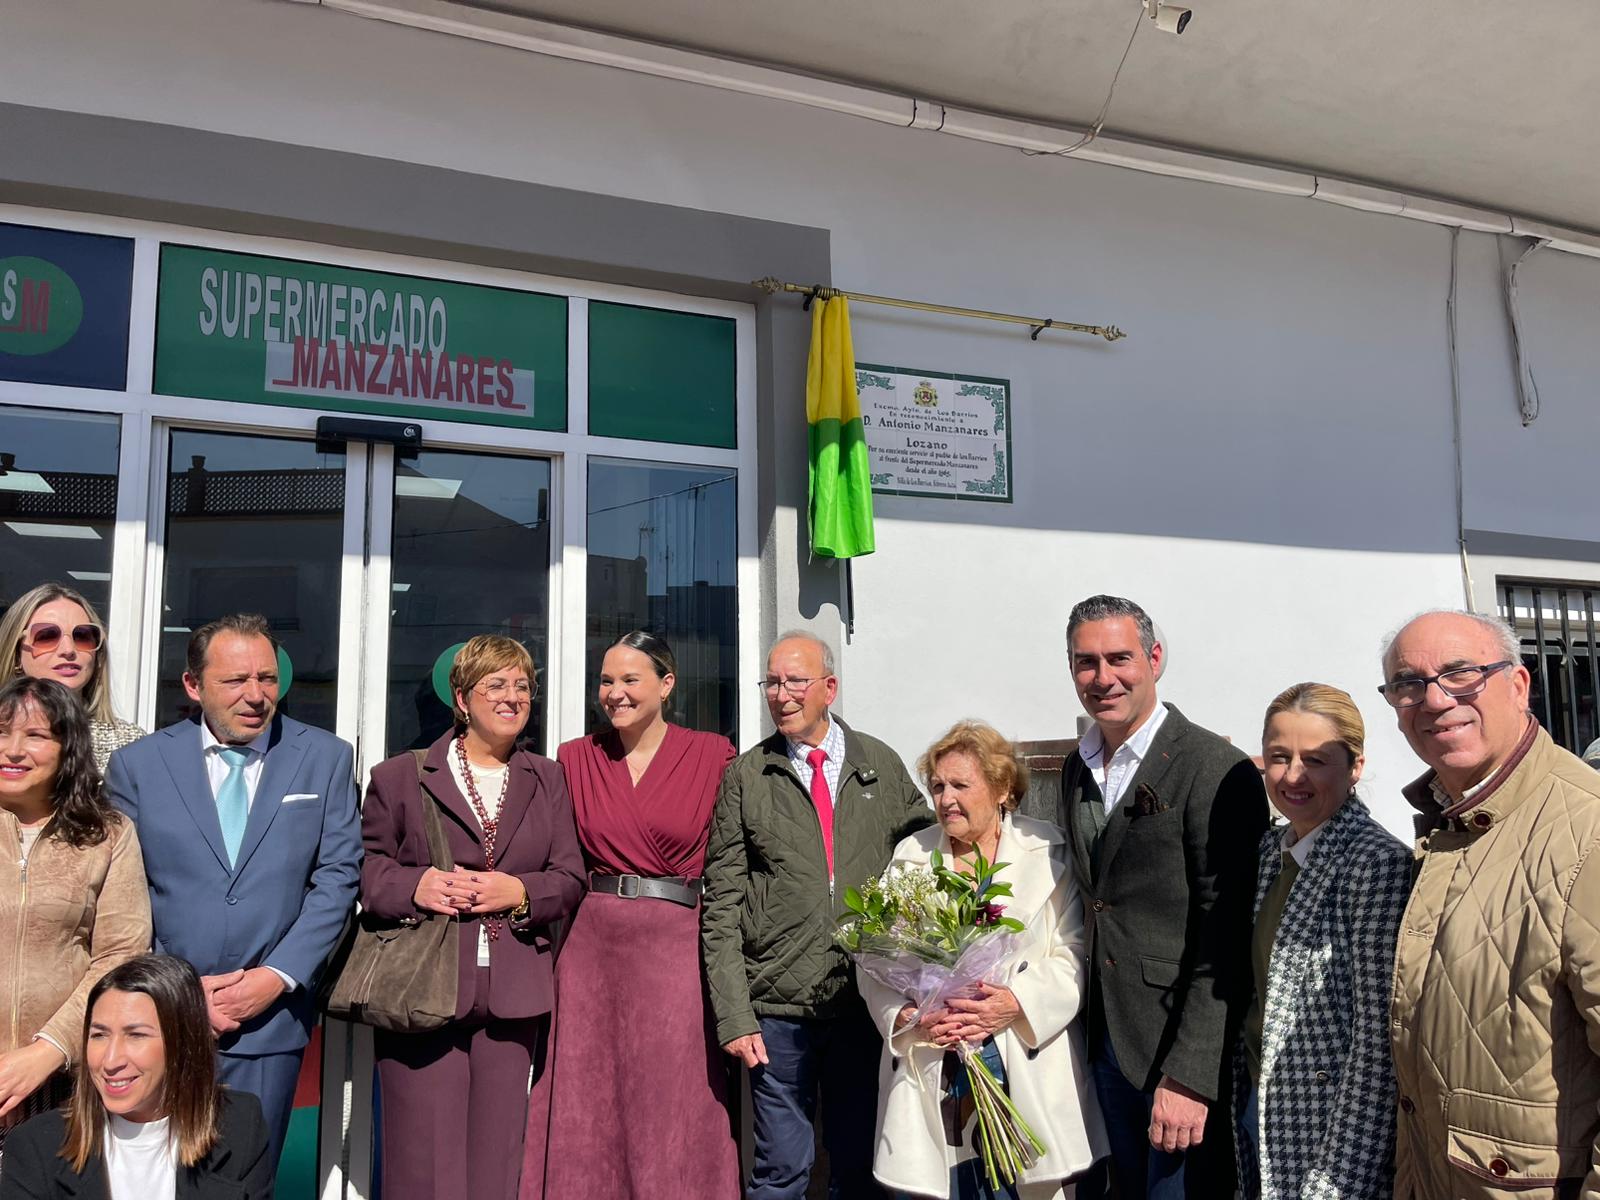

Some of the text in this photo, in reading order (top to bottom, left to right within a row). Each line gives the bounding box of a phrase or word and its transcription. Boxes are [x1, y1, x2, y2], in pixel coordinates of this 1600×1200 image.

[199, 267, 448, 357] SUPERMERCADO
[272, 336, 526, 410] MANZANARES
[937, 409, 950, 417] Los
[951, 411, 978, 419] Barrios
[879, 417, 921, 430] Antonio
[924, 422, 989, 436] Manzanares
[907, 437, 948, 450] Lozano
